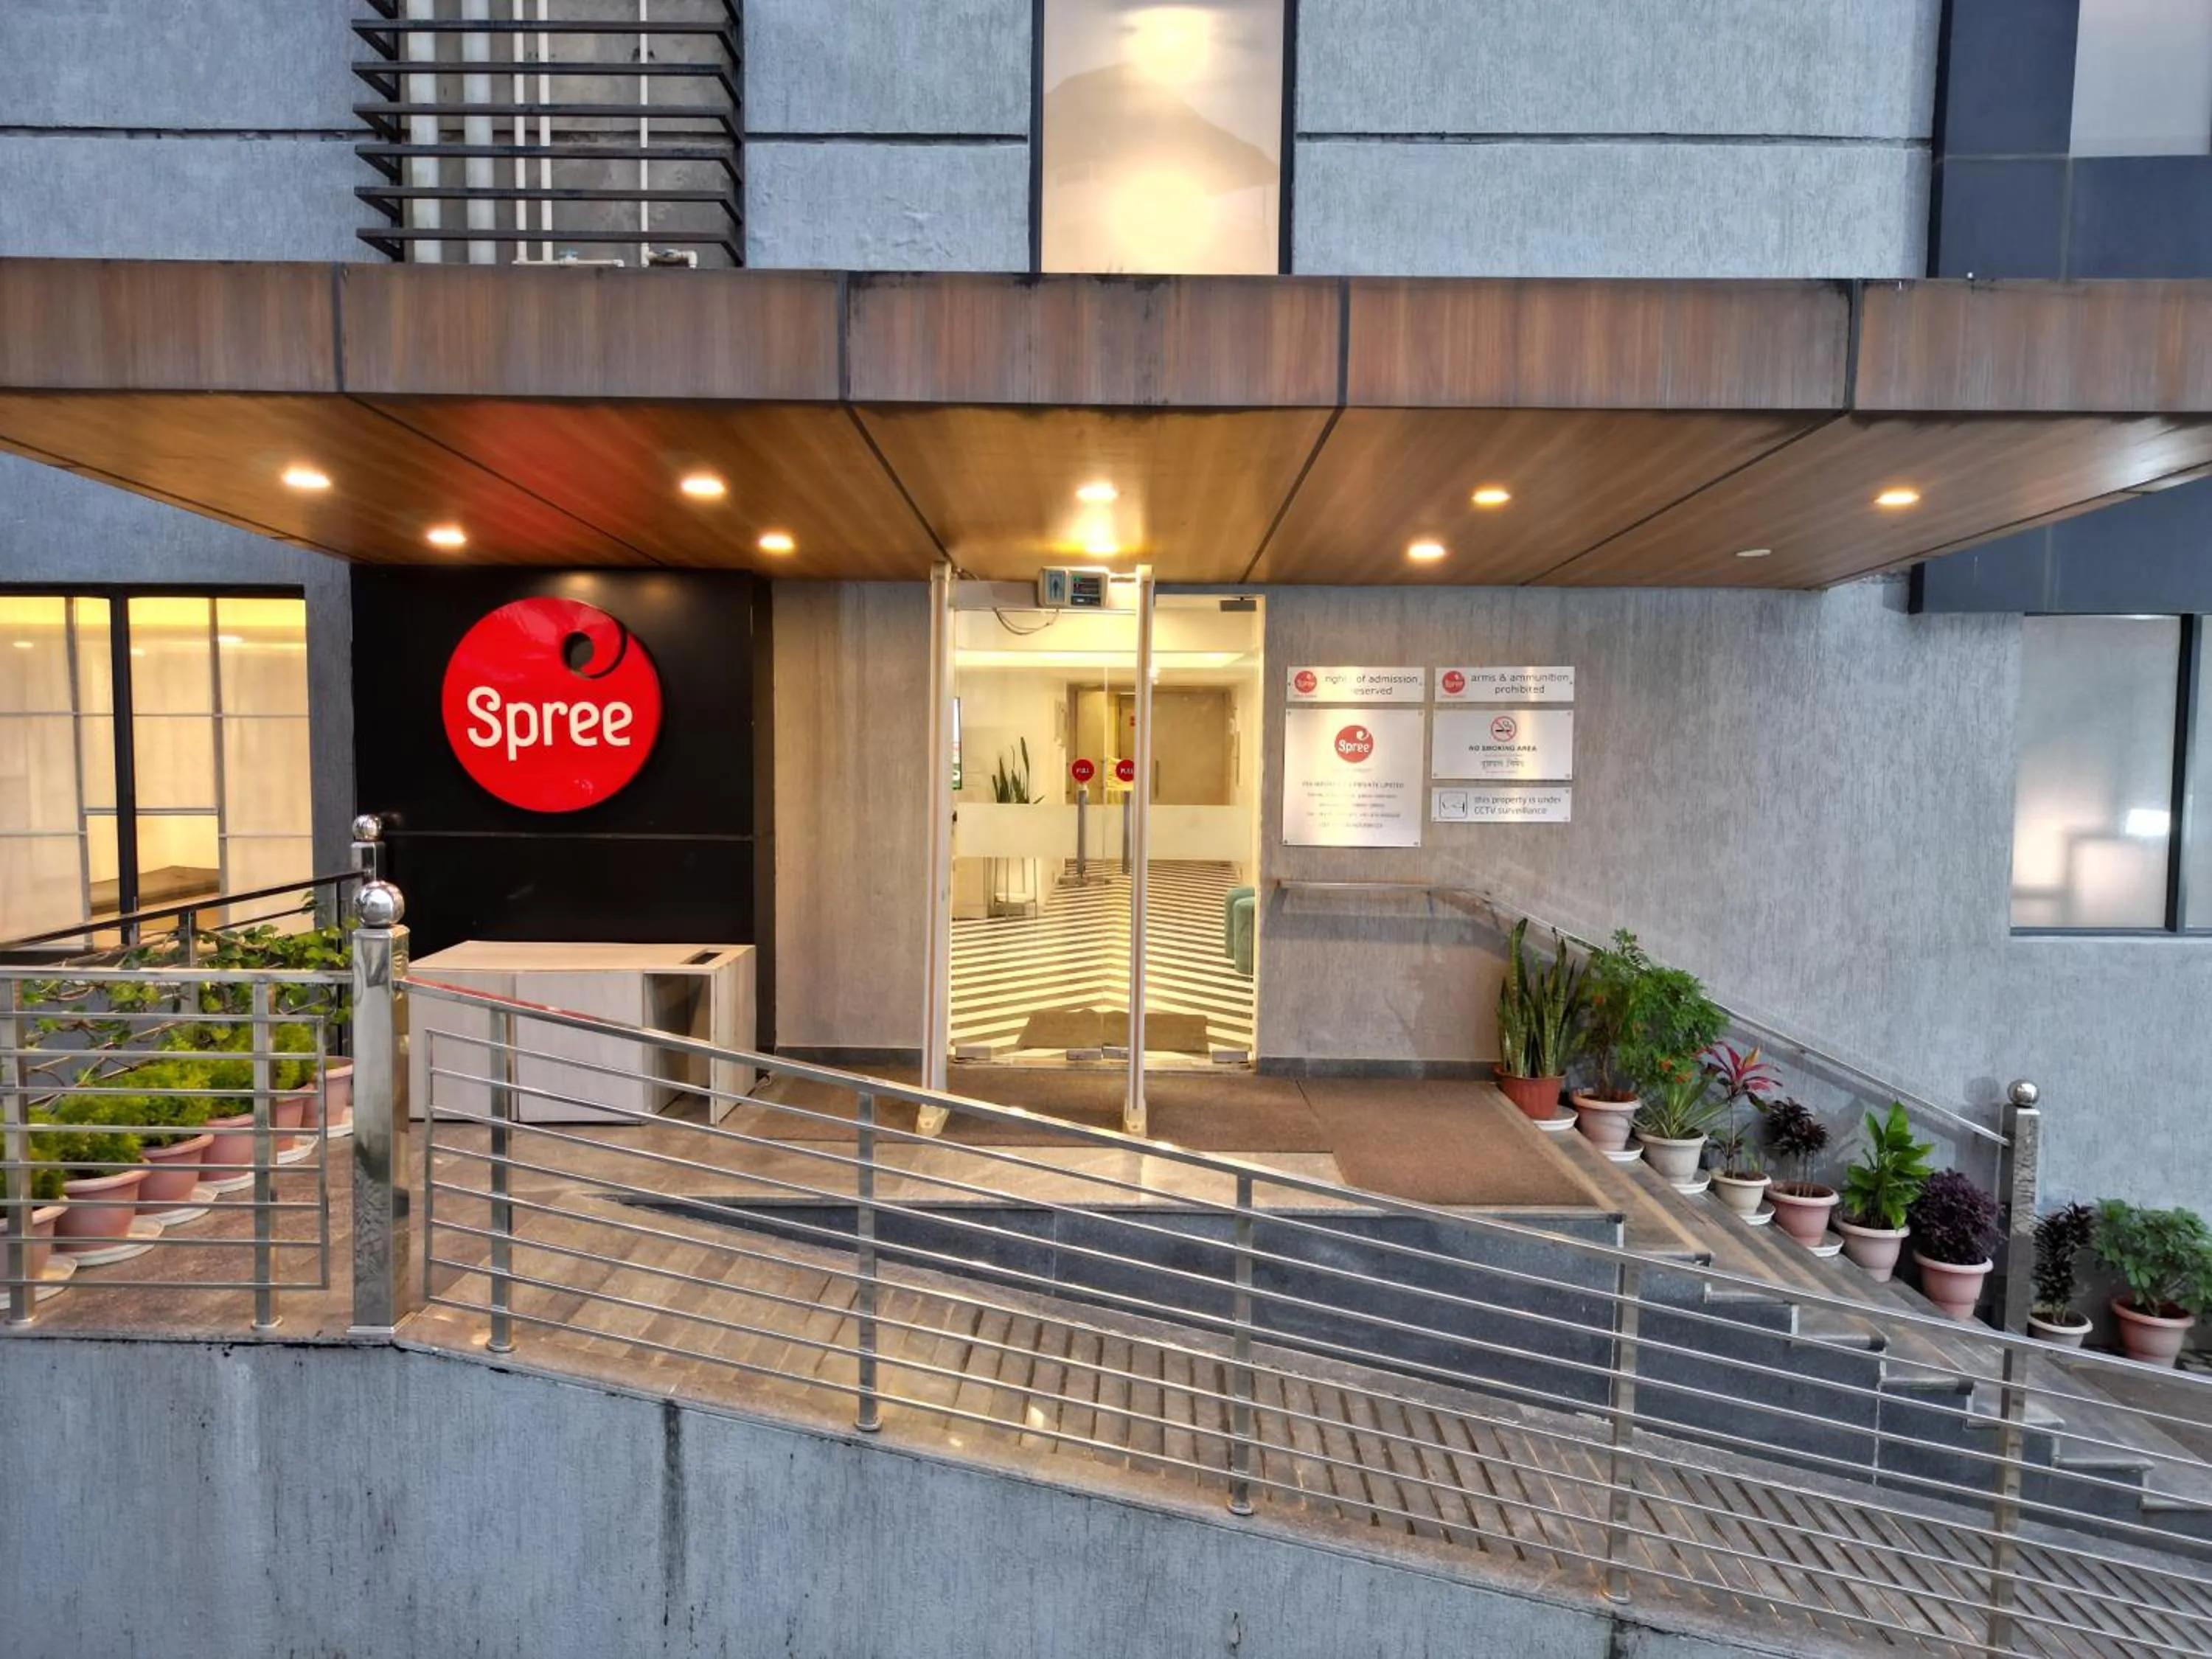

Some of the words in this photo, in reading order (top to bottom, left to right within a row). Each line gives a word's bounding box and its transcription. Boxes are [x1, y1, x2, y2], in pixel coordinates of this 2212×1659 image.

[1357, 675, 1366, 683] of
[1369, 674, 1418, 683] admission
[1509, 673, 1568, 682] ammunition
[1495, 685, 1545, 694] prohibited
[467, 686, 633, 762] Spree
[1338, 740, 1370, 754] Spree
[1492, 796, 1526, 805] property
